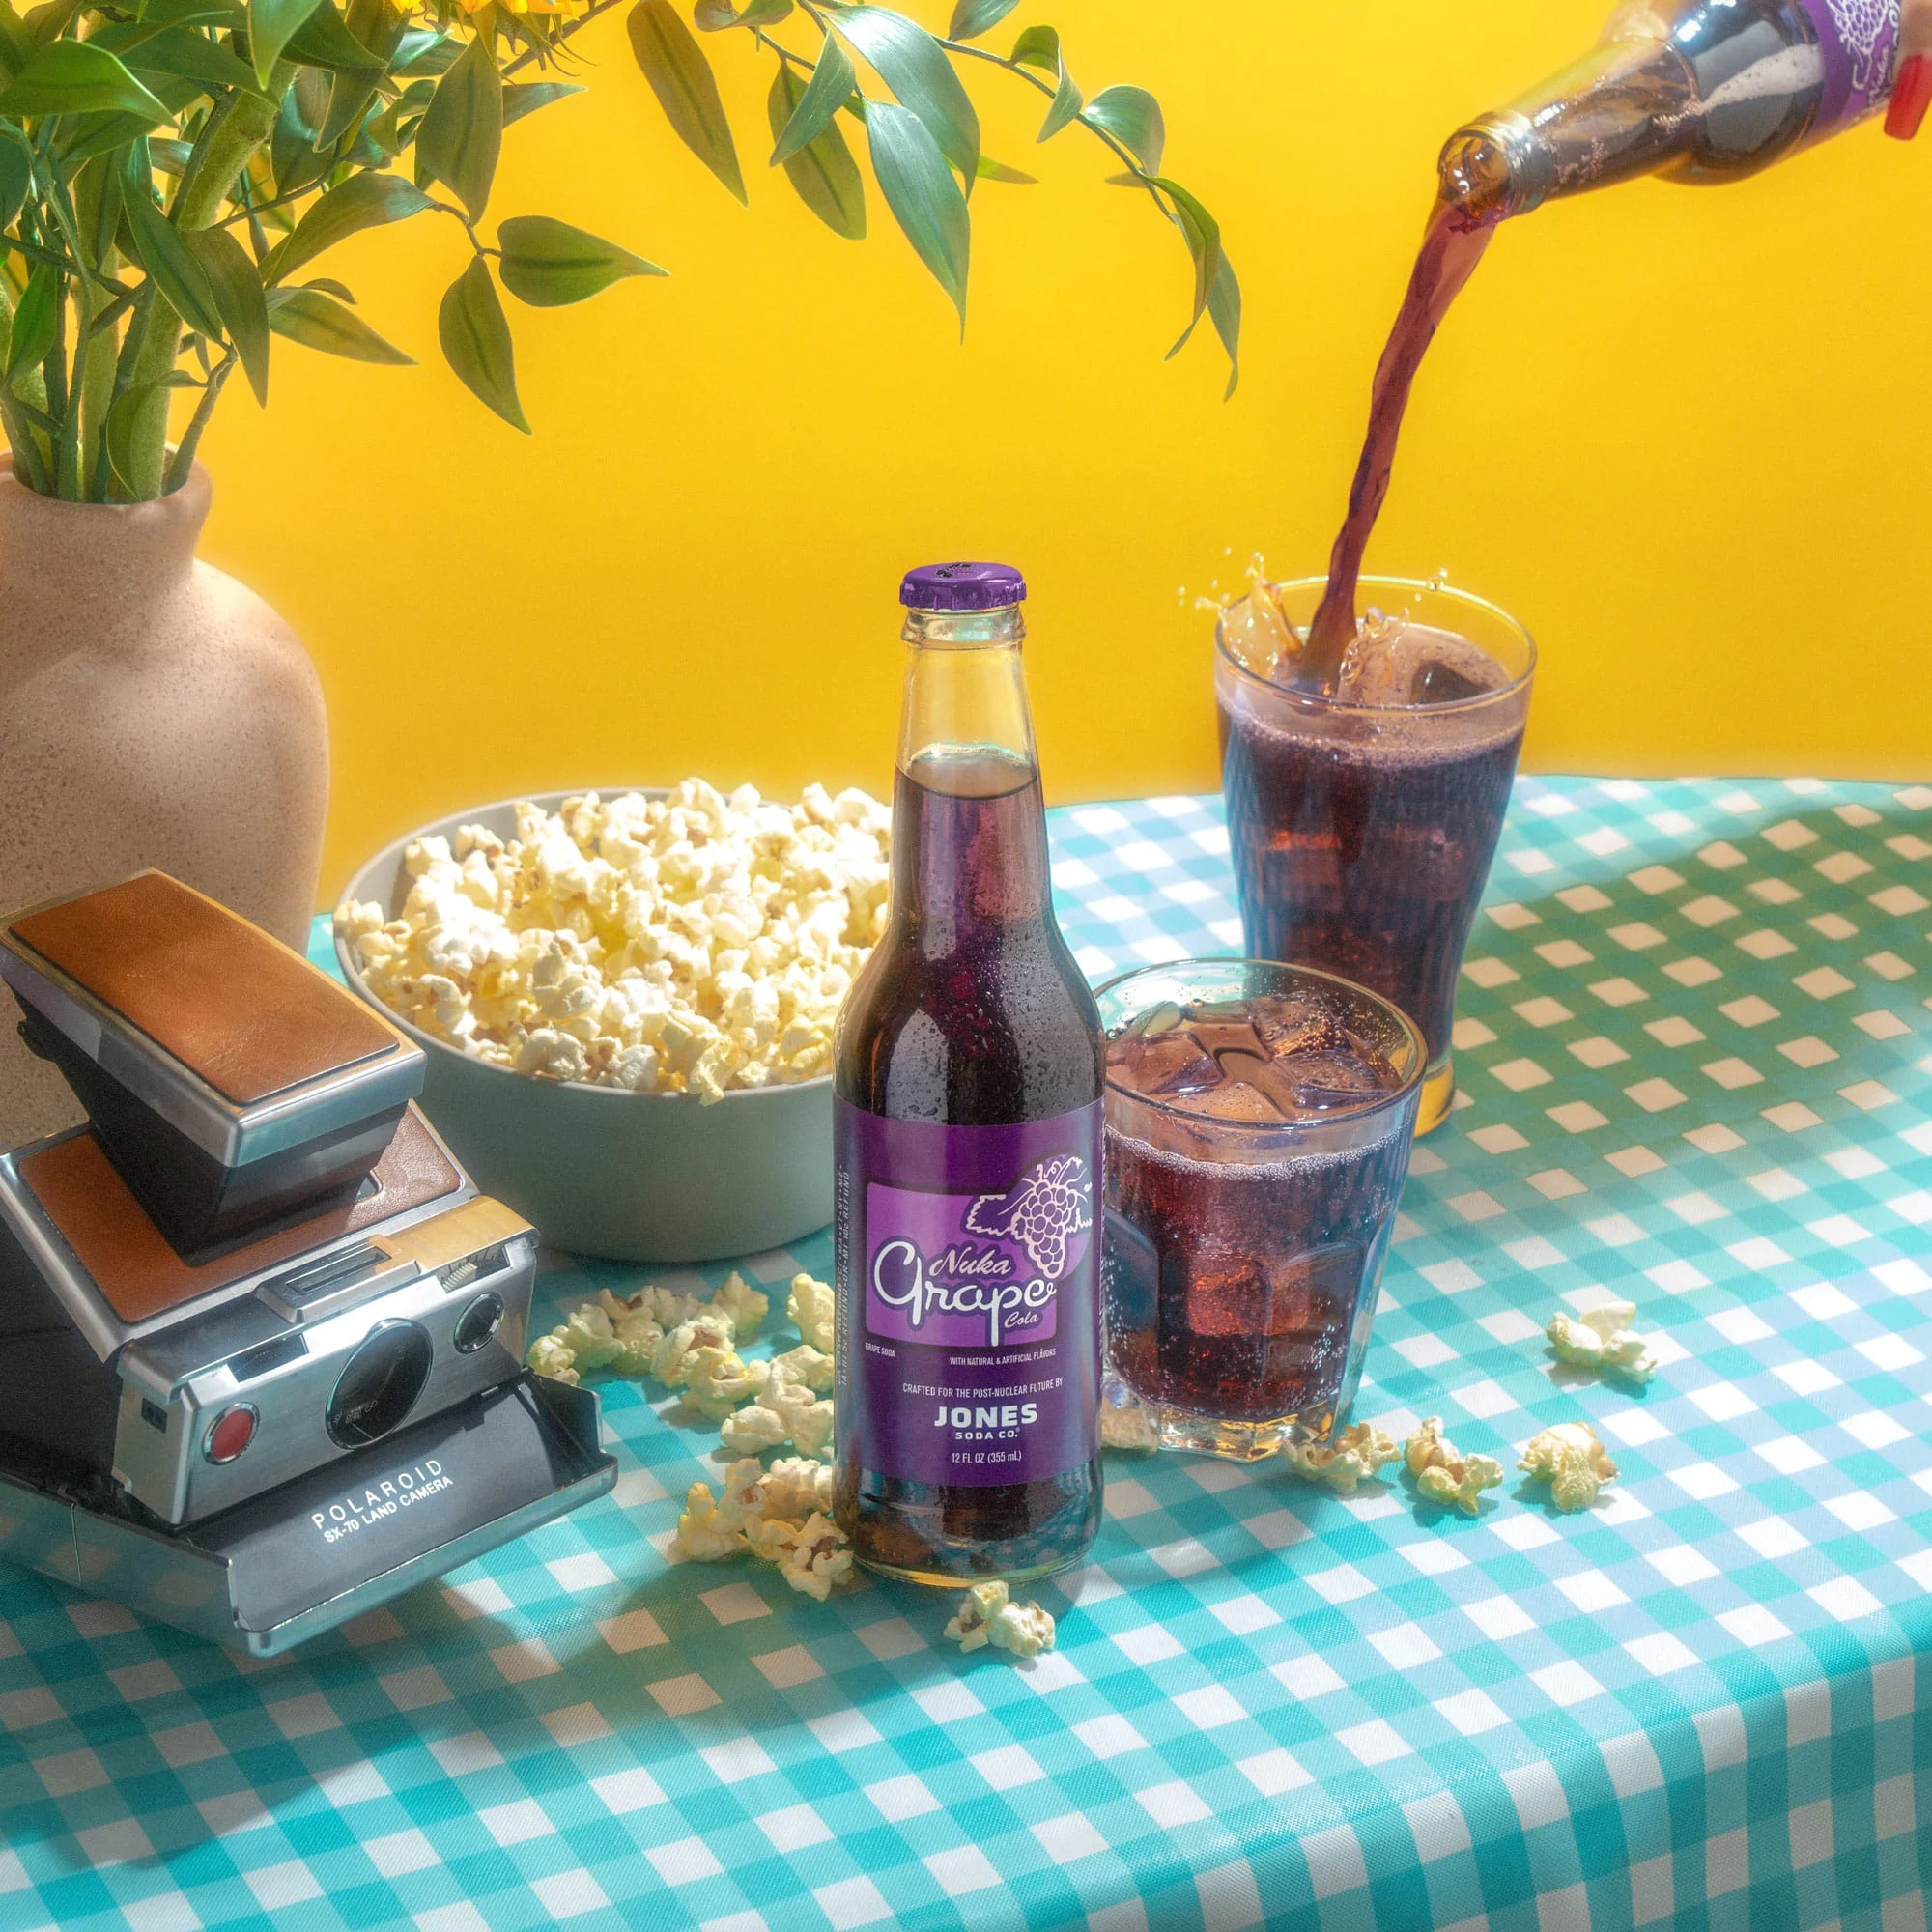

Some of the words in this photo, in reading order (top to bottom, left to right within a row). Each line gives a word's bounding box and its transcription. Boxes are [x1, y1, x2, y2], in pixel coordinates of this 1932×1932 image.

[929, 1247, 1012, 1276] Nuka
[874, 1241, 1057, 1347] Grape
[1004, 1311, 1039, 1328] Cola
[865, 1342, 881, 1354] GRAPE
[881, 1347, 895, 1357] SODA
[950, 1357, 966, 1366] WITH
[967, 1356, 994, 1366] NATURAL
[1002, 1353, 1032, 1364] ARTIFICIAL
[1033, 1348, 1057, 1361] FLAVORS
[902, 1382, 936, 1396] CRAFTED
[937, 1387, 953, 1398] FOR
[956, 1388, 971, 1398] THE
[973, 1384, 1028, 1398] POST-NUCLEAR
[1029, 1379, 1054, 1392] FUTURE
[1055, 1377, 1064, 1387] BY
[934, 1403, 1037, 1429] JONES
[954, 1431, 994, 1440] SODA
[951, 1452, 960, 1463] 12
[962, 1453, 973, 1463] FL
[975, 1453, 985, 1463] OZ
[987, 1452, 1006, 1463] (355
[311, 1460, 442, 1530] POLAROID
[323, 1519, 360, 1544] SX-70
[361, 1501, 398, 1525] LAND
[399, 1476, 454, 1507] CAMERA
